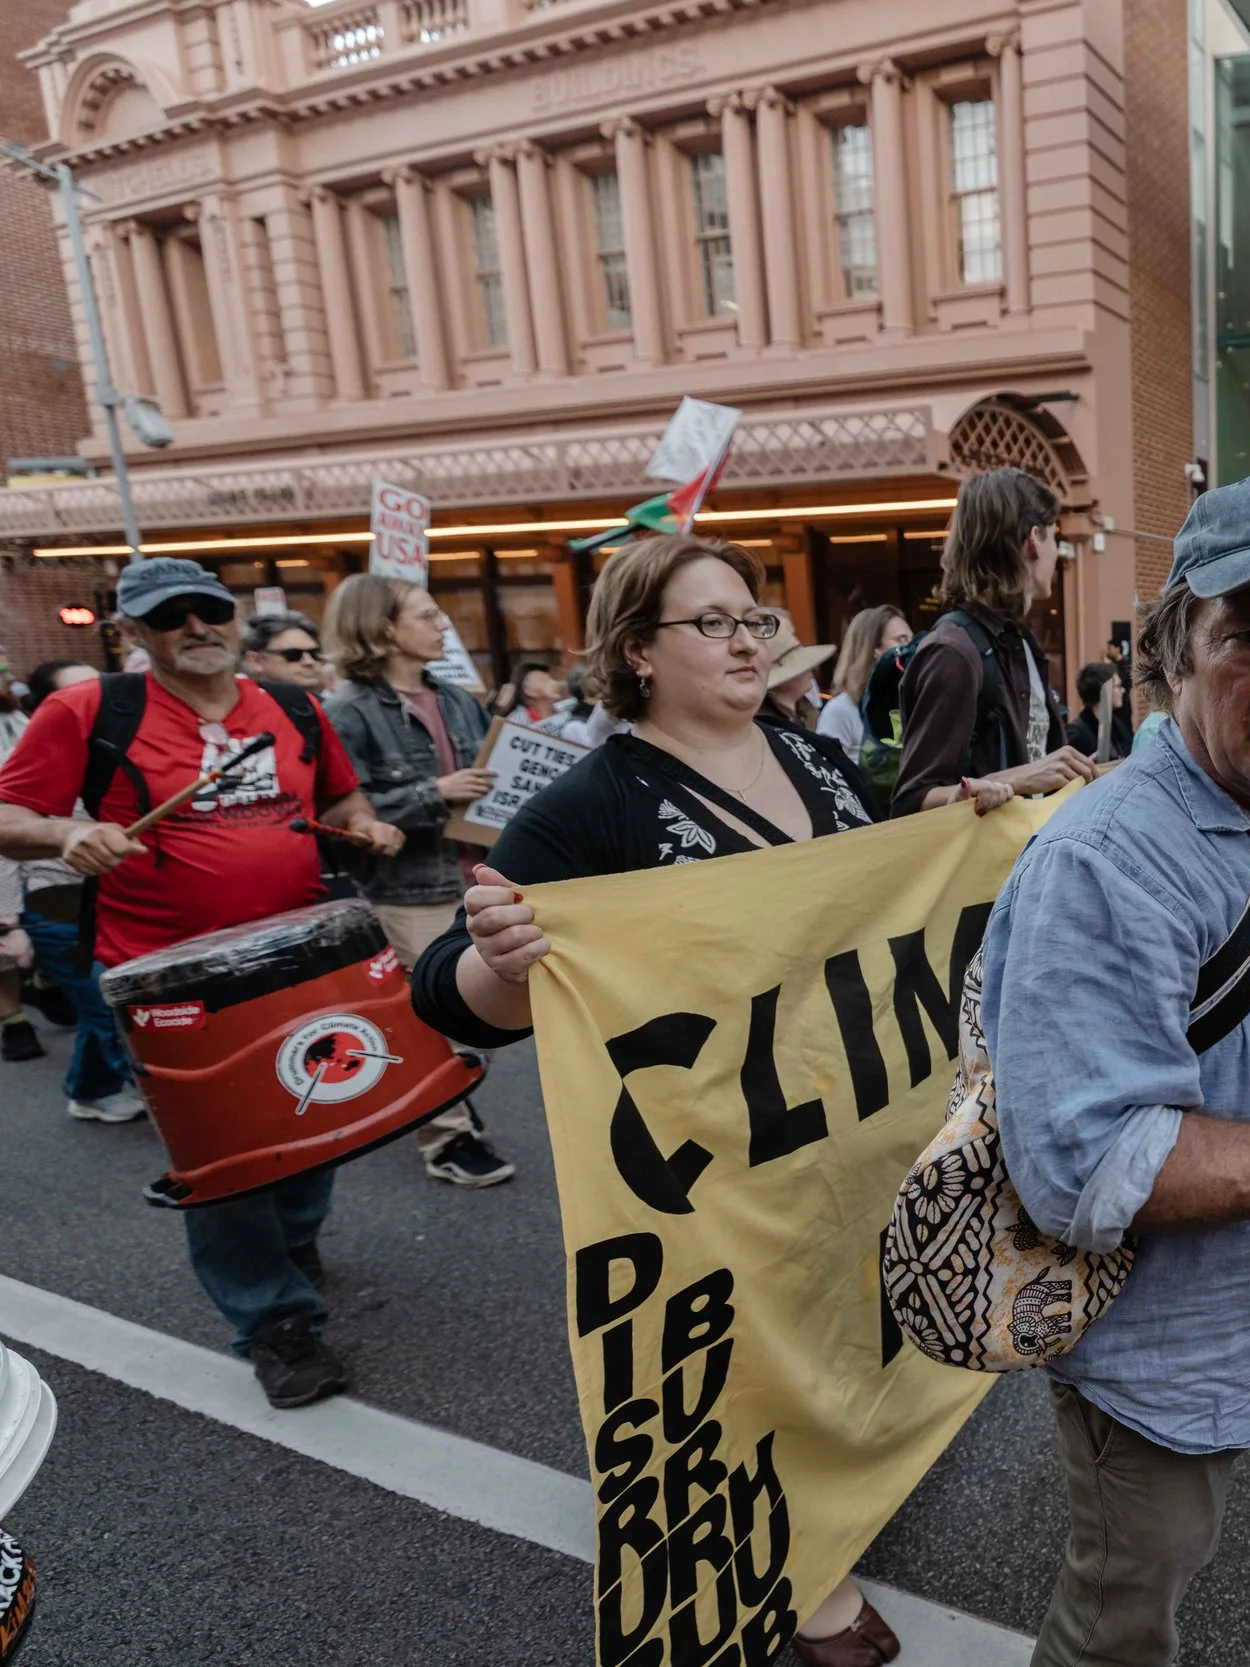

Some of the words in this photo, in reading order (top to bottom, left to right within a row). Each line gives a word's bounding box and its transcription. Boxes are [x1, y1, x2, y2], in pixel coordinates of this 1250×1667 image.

[378, 489, 427, 519] GO
[377, 531, 424, 569] USA
[509, 735, 543, 755] CUT
[662, 1268, 741, 1667] BURRU
